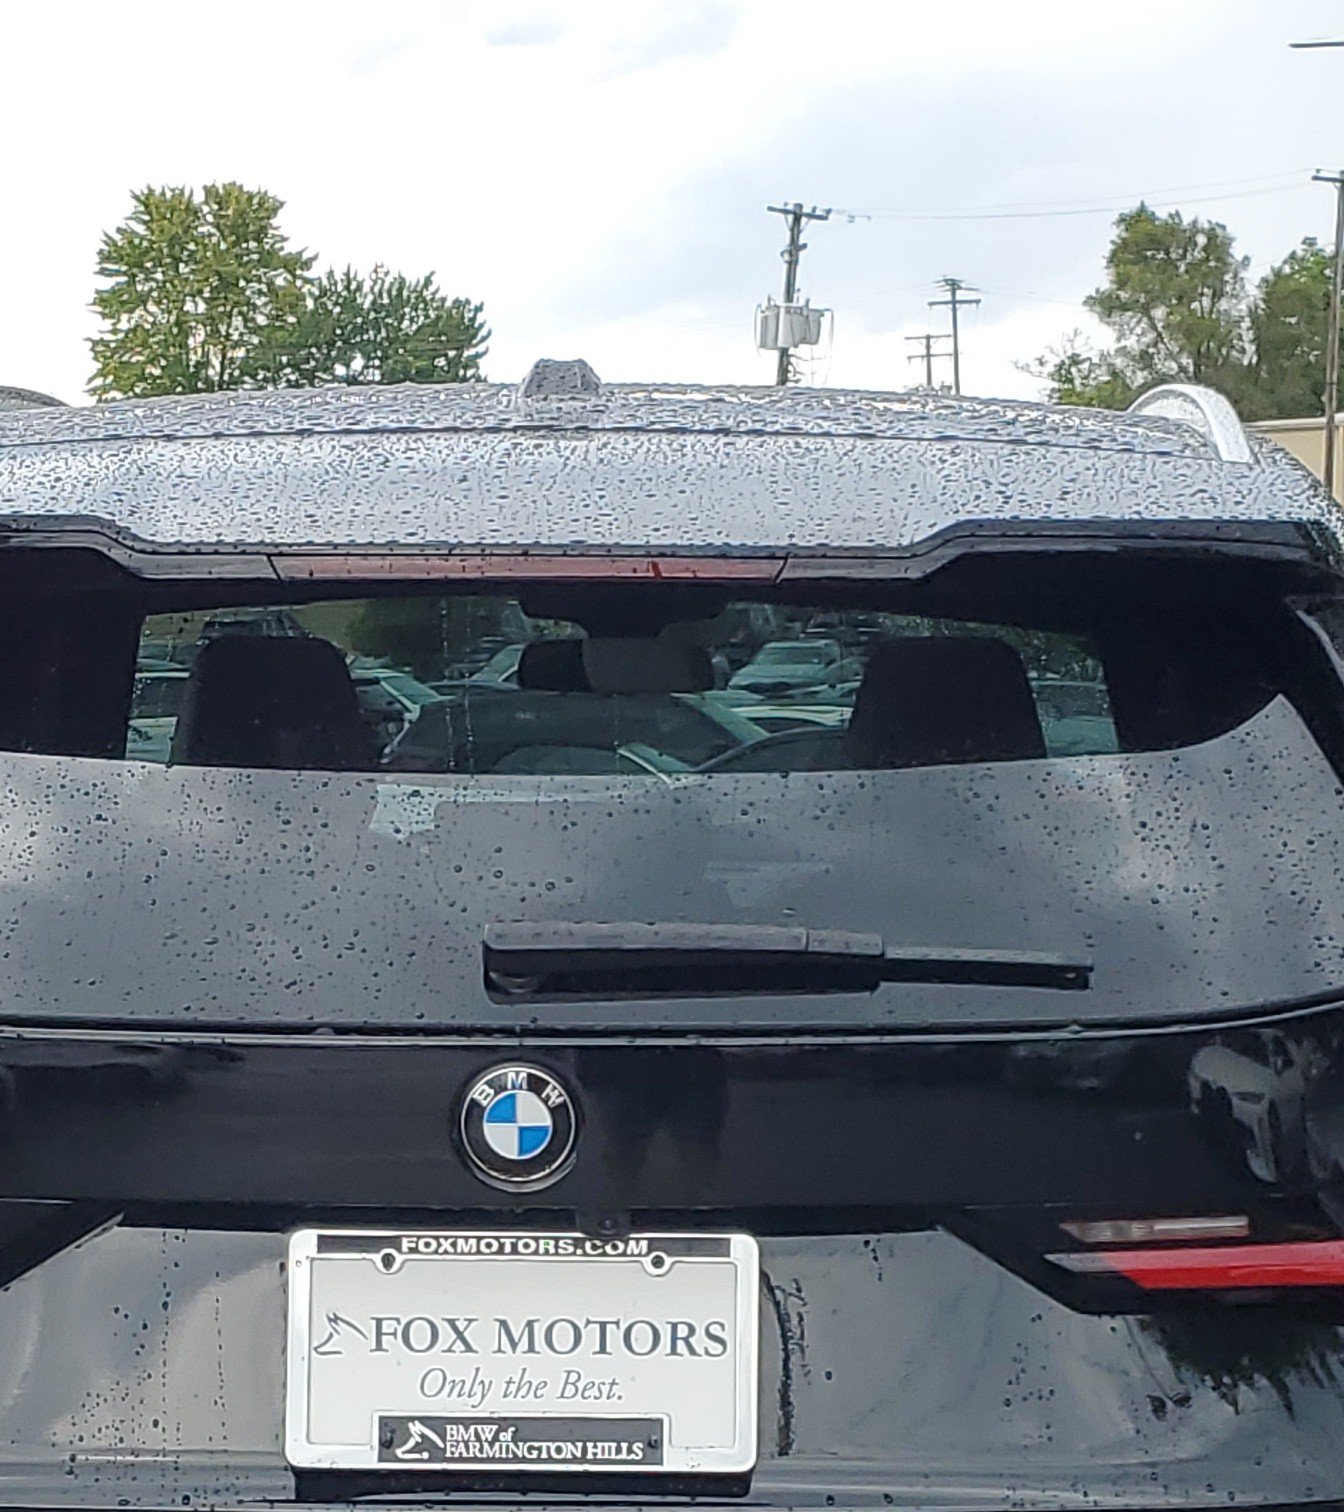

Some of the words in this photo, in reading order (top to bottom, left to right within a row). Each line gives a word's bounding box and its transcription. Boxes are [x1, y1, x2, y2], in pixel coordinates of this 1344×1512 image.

[472, 1072, 564, 1108] BMW
[401, 1236, 649, 1256] FOXMOTORS.COM
[369, 1316, 479, 1354] FOX
[492, 1319, 728, 1357] MOTORS
[419, 1367, 492, 1408] Only
[502, 1369, 548, 1400] the
[556, 1370, 624, 1401] Best.
[445, 1424, 498, 1441] BMW
[499, 1425, 516, 1441] of
[445, 1441, 586, 1459] FARMINGTON
[586, 1442, 644, 1460] HILLS
